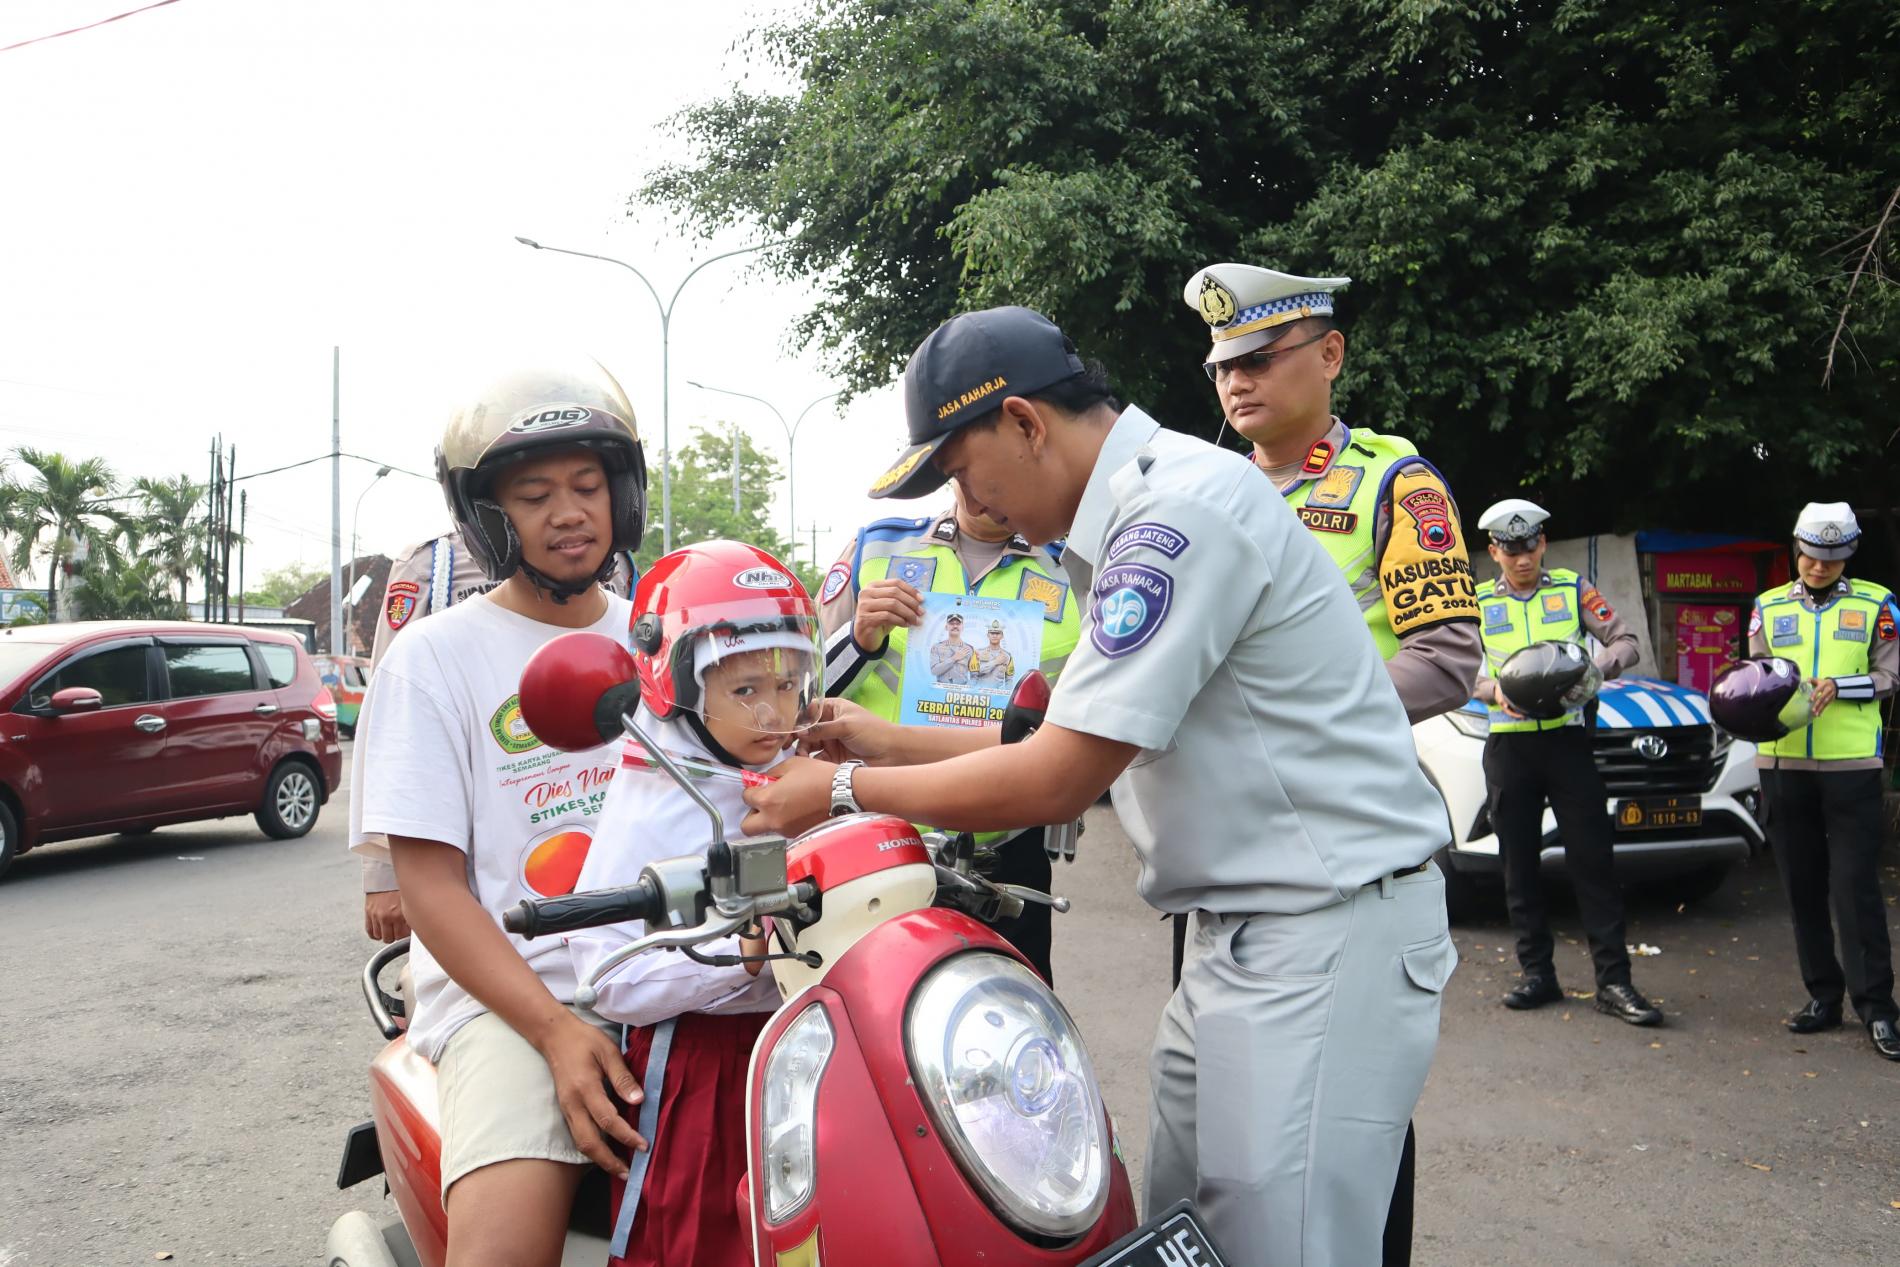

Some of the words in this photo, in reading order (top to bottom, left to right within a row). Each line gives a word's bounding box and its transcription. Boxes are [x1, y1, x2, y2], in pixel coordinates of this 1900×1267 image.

[937, 400, 961, 419] JASA
[960, 376, 1007, 407] RAHARJA
[522, 410, 581, 427] VOG
[1301, 512, 1348, 531] POLRI
[1140, 529, 1176, 550] JATENG
[1100, 576, 1119, 592] JASA
[1121, 573, 1163, 598] RAHARJA
[1666, 573, 1713, 588] MARTABAK
[945, 692, 991, 707] OPERASI
[917, 700, 950, 715] ZEBRA
[953, 705, 986, 719] CANDI
[989, 708, 1005, 720] 20
[928, 714, 960, 724] SATLANTAS
[512, 759, 551, 773] SEMARANG
[524, 780, 573, 808] Dies
[530, 798, 586, 824] STIKES
[876, 837, 925, 852] HONDA
